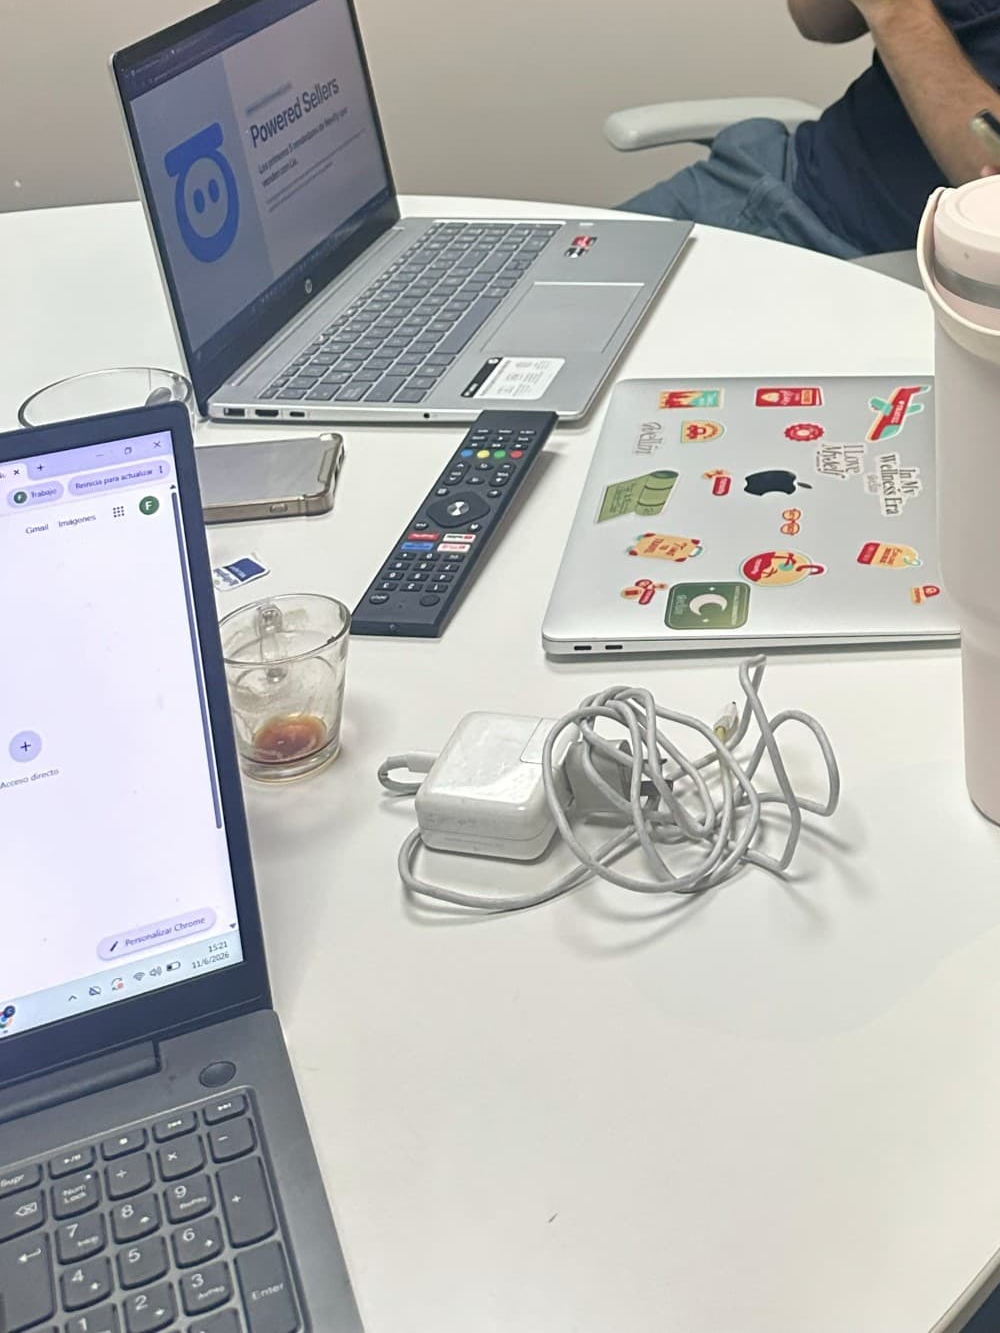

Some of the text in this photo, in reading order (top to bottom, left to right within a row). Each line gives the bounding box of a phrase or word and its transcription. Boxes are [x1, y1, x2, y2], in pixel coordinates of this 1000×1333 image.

[250, 97, 303, 148] Powered
[302, 78, 339, 114] Sellers
[103, 476, 120, 486] para
[121, 469, 153, 482] actualizar
[880, 454, 902, 515] Wellness Era
[25, 524, 49, 535] Gmail
[125, 917, 206, 946] Personalizar Chrome
[174, 1185, 187, 1198] 9
[121, 1204, 134, 1218] 8
[66, 1223, 79, 1238] 7
[182, 1228, 195, 1242] 6
[128, 1248, 141, 1263] 5
[71, 1269, 84, 1283] 4
[191, 1273, 204, 1288] 3
[252, 1282, 284, 1300] Enter
[135, 1295, 149, 1311] 2
[79, 1317, 88, 1331] 1
